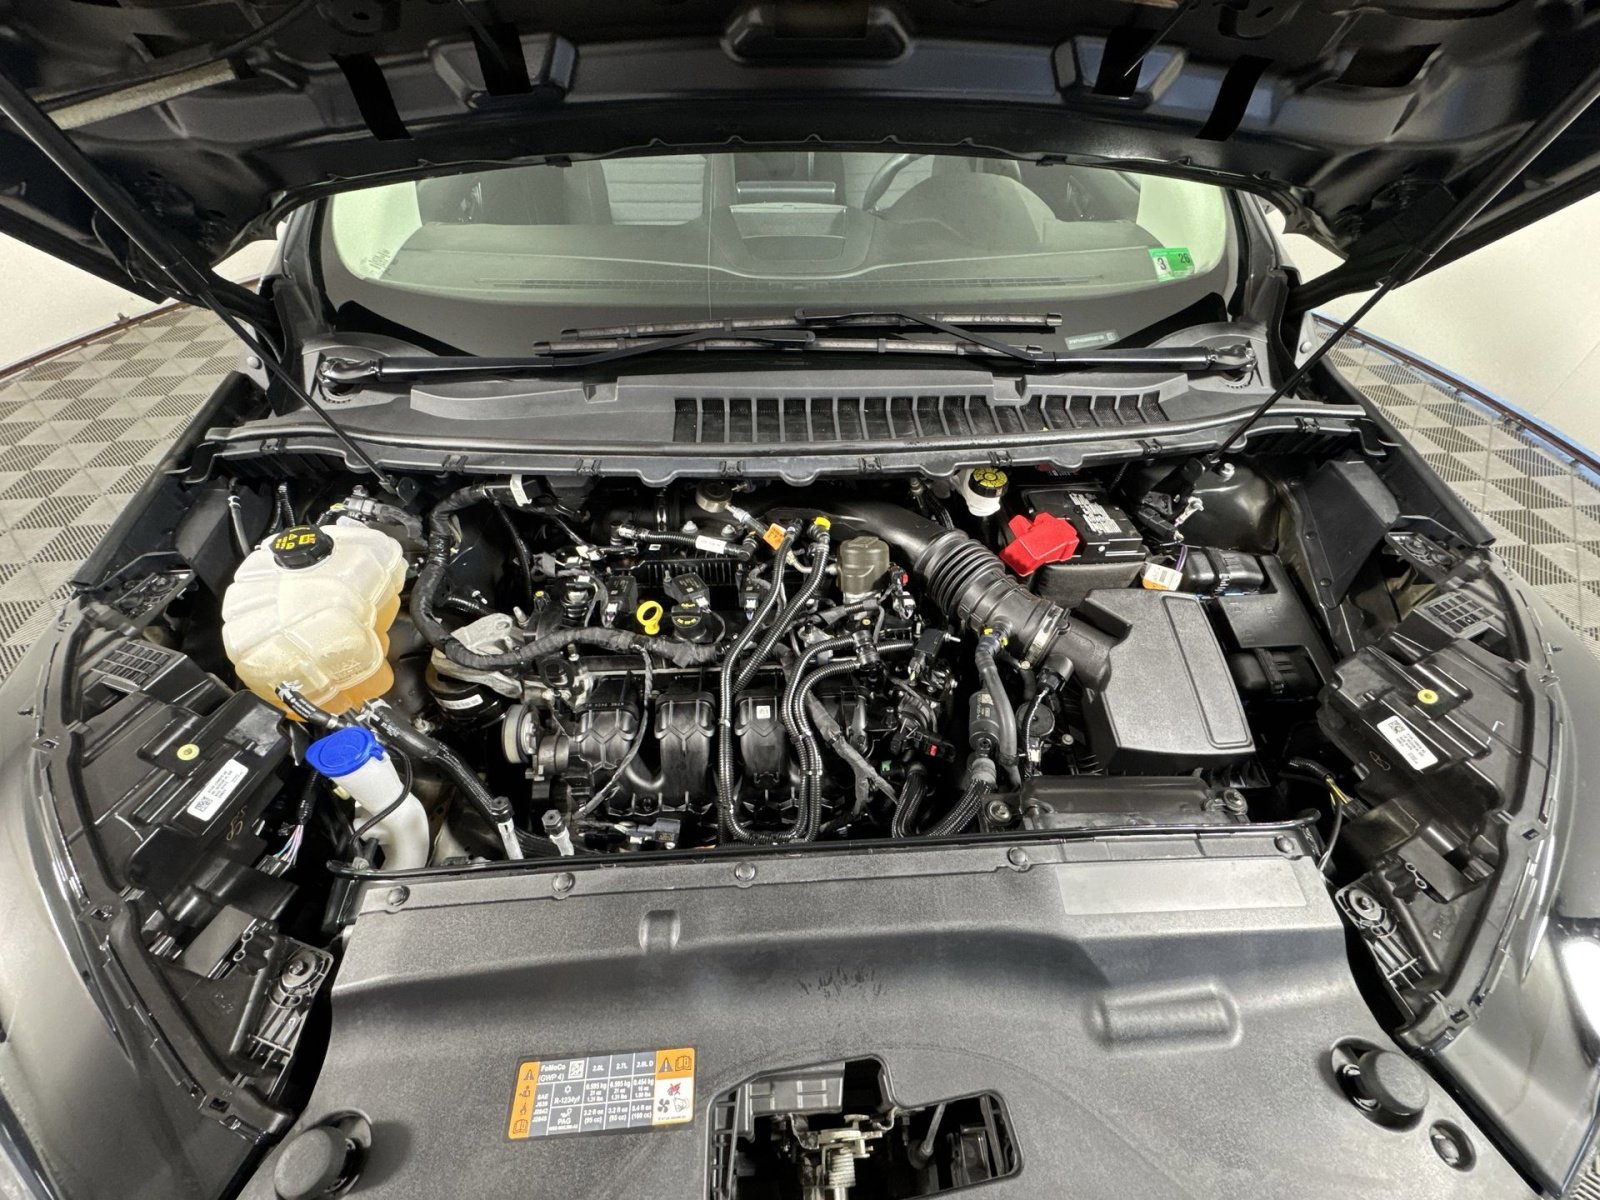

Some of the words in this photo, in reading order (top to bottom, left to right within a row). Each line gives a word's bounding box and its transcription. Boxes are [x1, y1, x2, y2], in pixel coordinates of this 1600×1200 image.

[1157, 257, 1166, 270] 3
[541, 1064, 566, 1072] FoMoCo
[538, 1073, 557, 1083] (GWP
[558, 1073, 564, 1081] 4)
[624, 1080, 630, 1088] kg
[554, 1096, 580, 1104] R-1234yf
